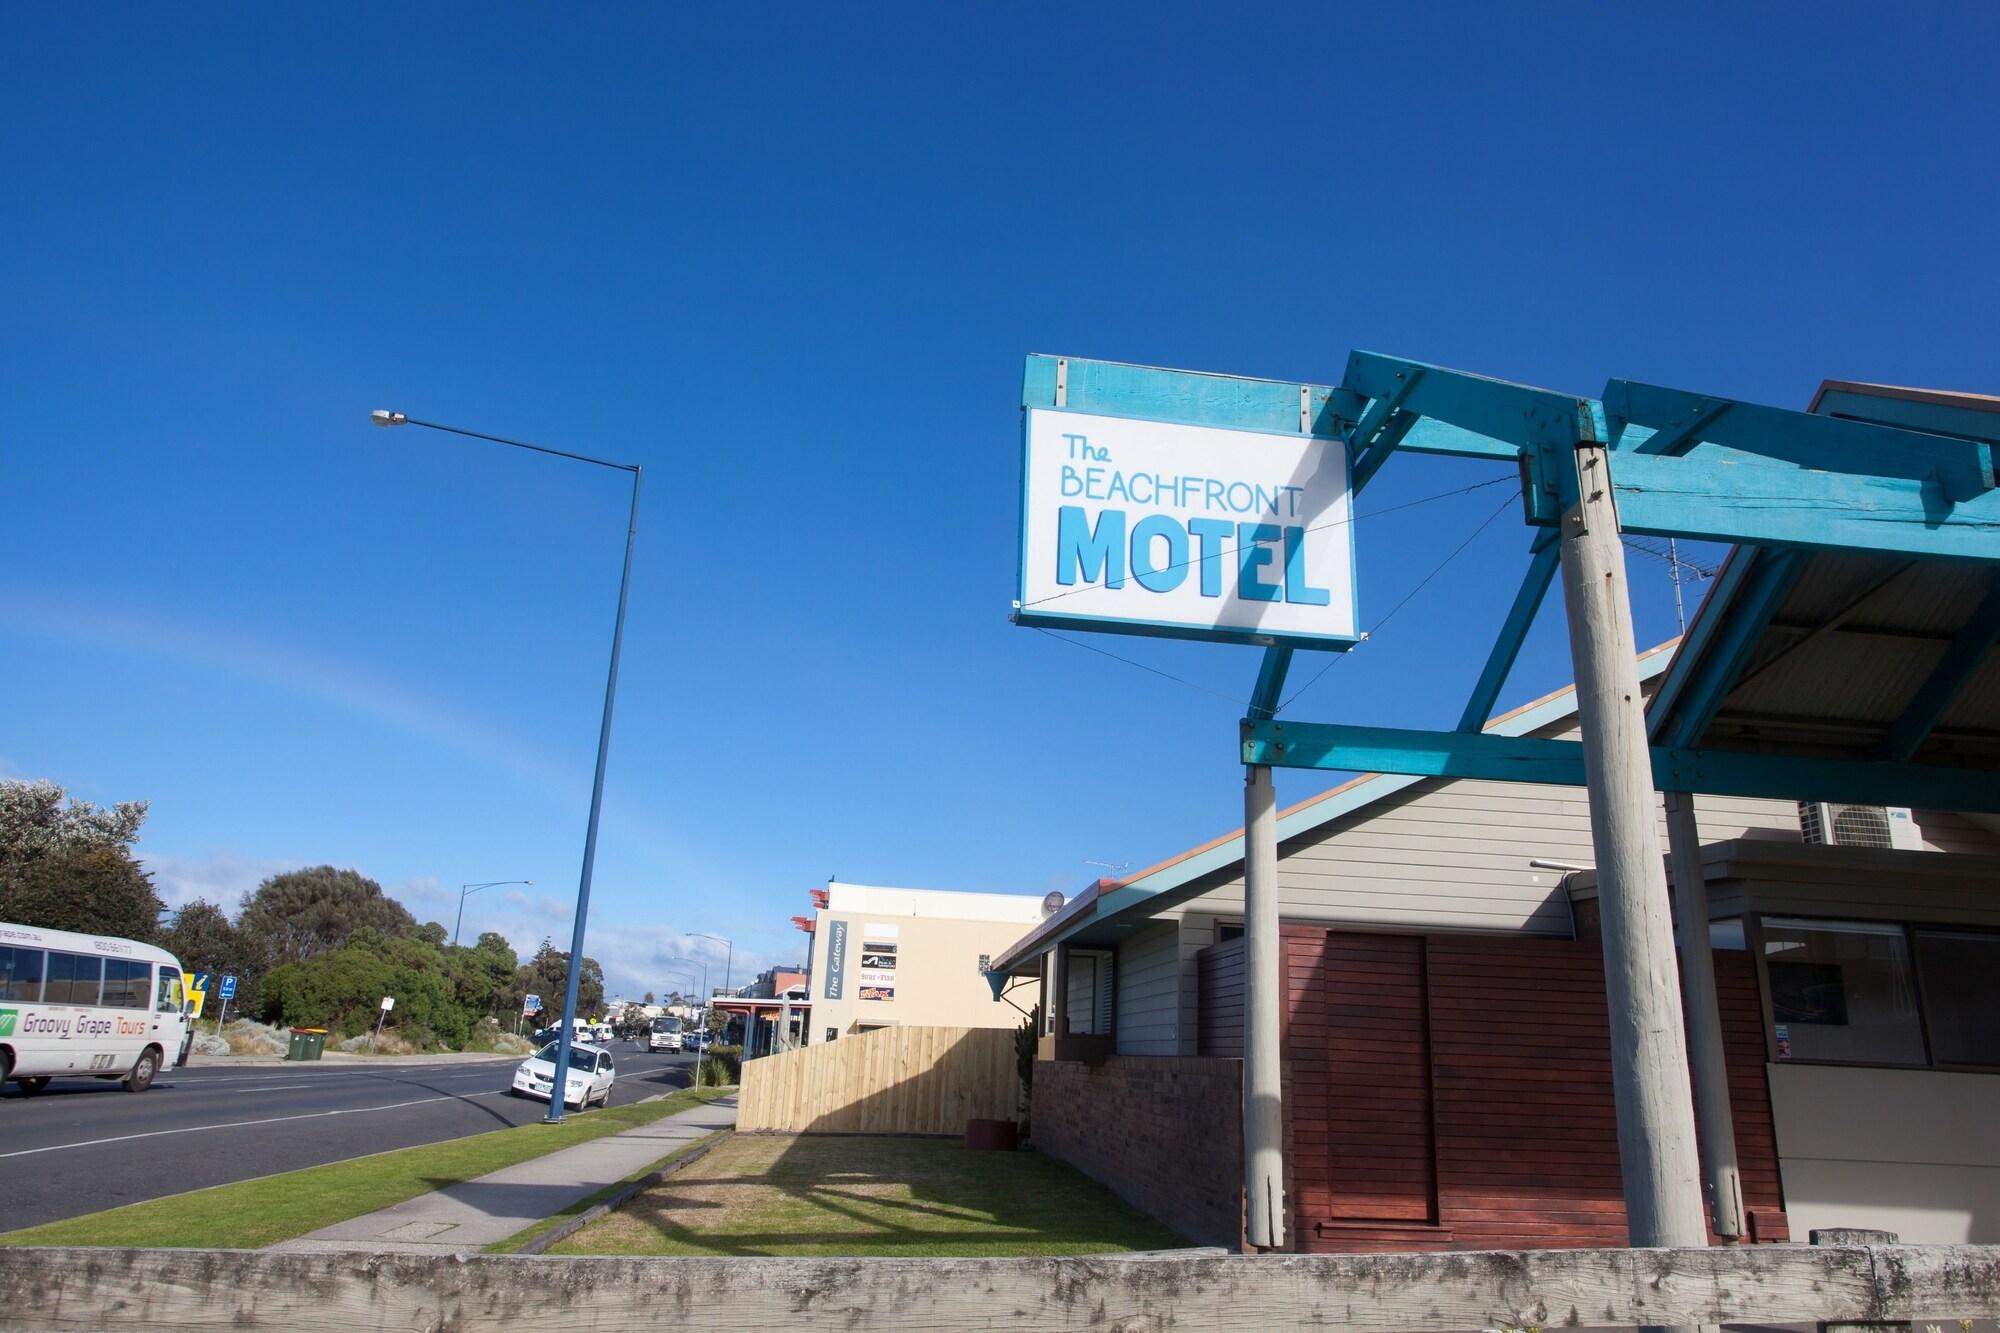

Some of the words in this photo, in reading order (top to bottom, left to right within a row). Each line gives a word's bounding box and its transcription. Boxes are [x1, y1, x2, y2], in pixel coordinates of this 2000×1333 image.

[1061, 432, 1113, 463] The
[1060, 465, 1305, 518] BEACHFRONT
[1056, 505, 1331, 607] MOTEL
[831, 923, 846, 973] Gateway
[225, 978, 233, 986] P
[828, 976, 839, 998] The
[23, 1013, 72, 1037] Groovy
[76, 1015, 112, 1038] Grape
[116, 1016, 146, 1035] Tours
